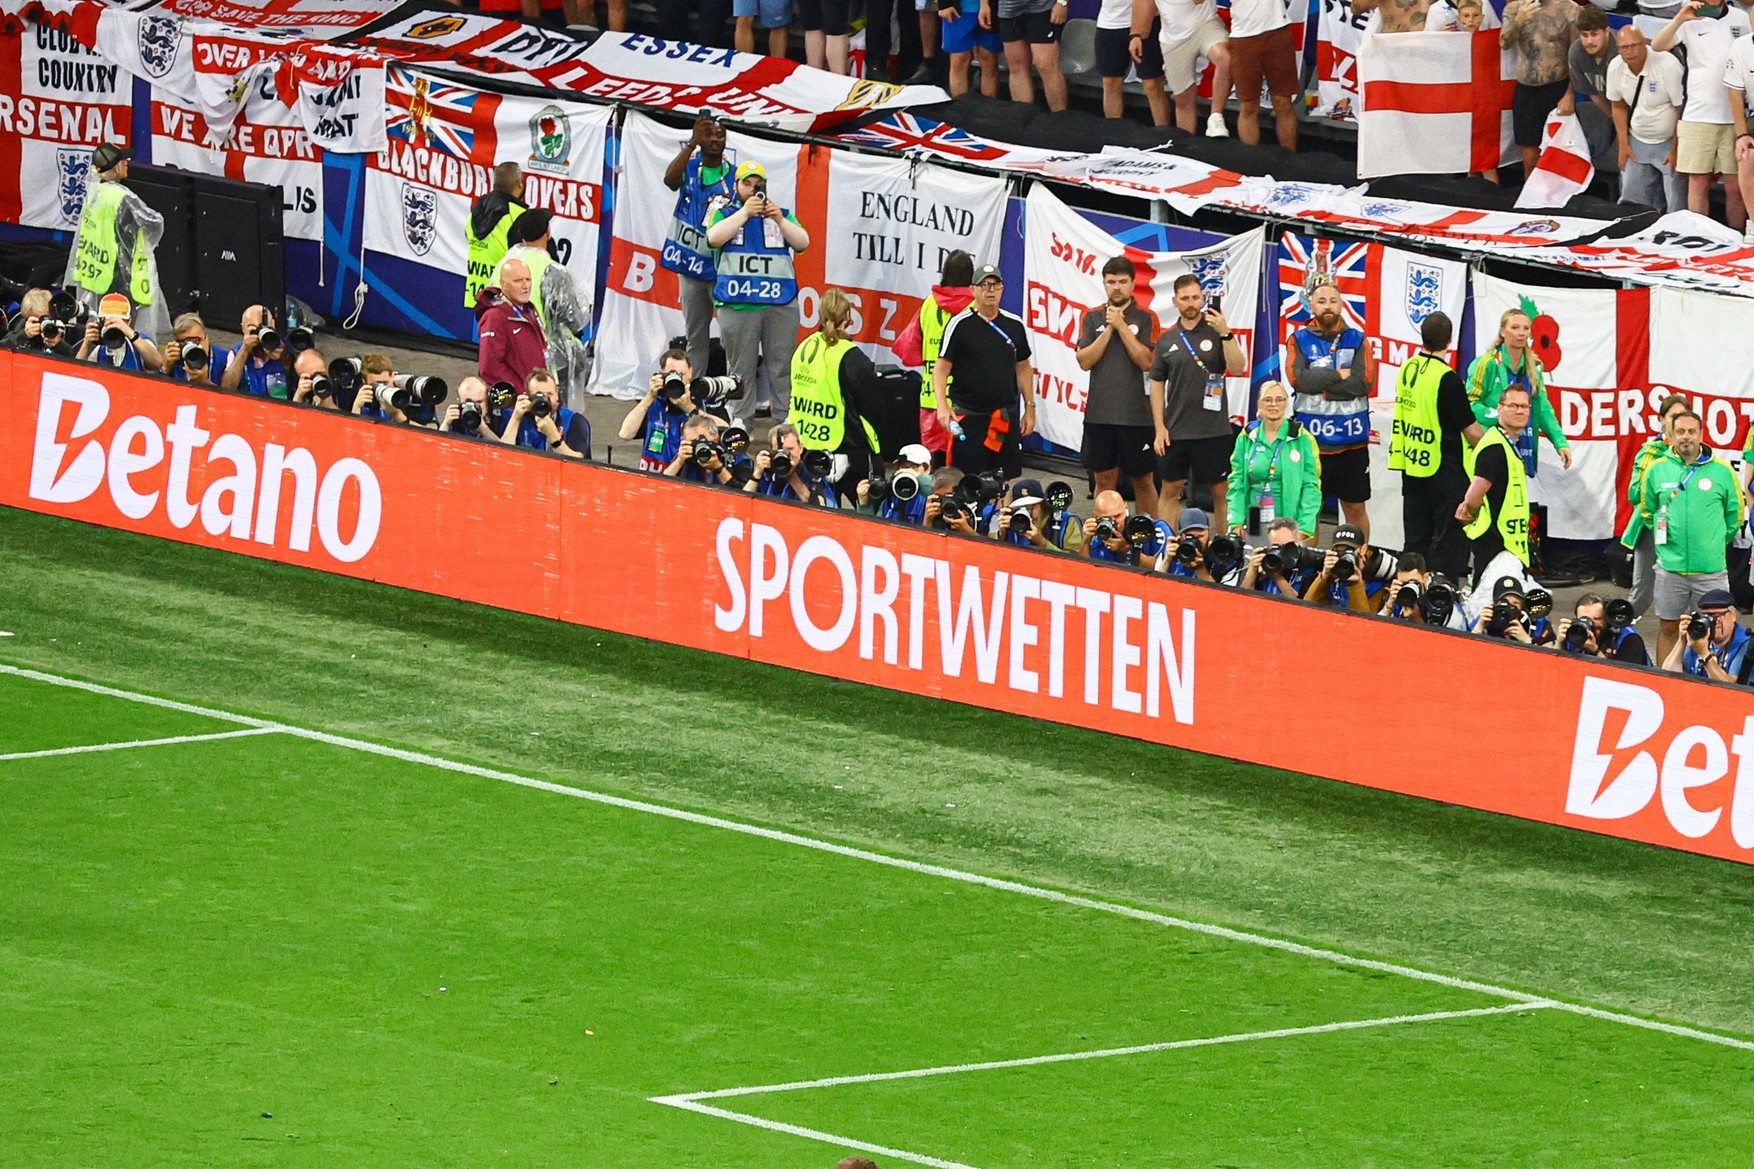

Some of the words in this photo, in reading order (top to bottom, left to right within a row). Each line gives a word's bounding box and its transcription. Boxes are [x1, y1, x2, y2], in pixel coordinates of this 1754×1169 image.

[211, 6, 264, 25] SAVE
[262, 12, 301, 24] THE
[196, 42, 252, 68] OVER
[619, 32, 738, 68] ESSEX
[160, 104, 196, 141] WE
[201, 125, 256, 154] ARE
[262, 127, 315, 159] QPR
[525, 175, 594, 220] OVERS
[859, 191, 974, 237] ENGLAND
[677, 224, 705, 250] ICT
[852, 232, 905, 266] TILL
[663, 245, 704, 275] 04-14
[738, 255, 773, 275] ICT
[727, 279, 781, 299] 04-28
[790, 395, 837, 420] WARD
[1308, 417, 1364, 437] 06-13
[28, 371, 382, 563] Betano
[714, 517, 1196, 725] SPORTWETTEN
